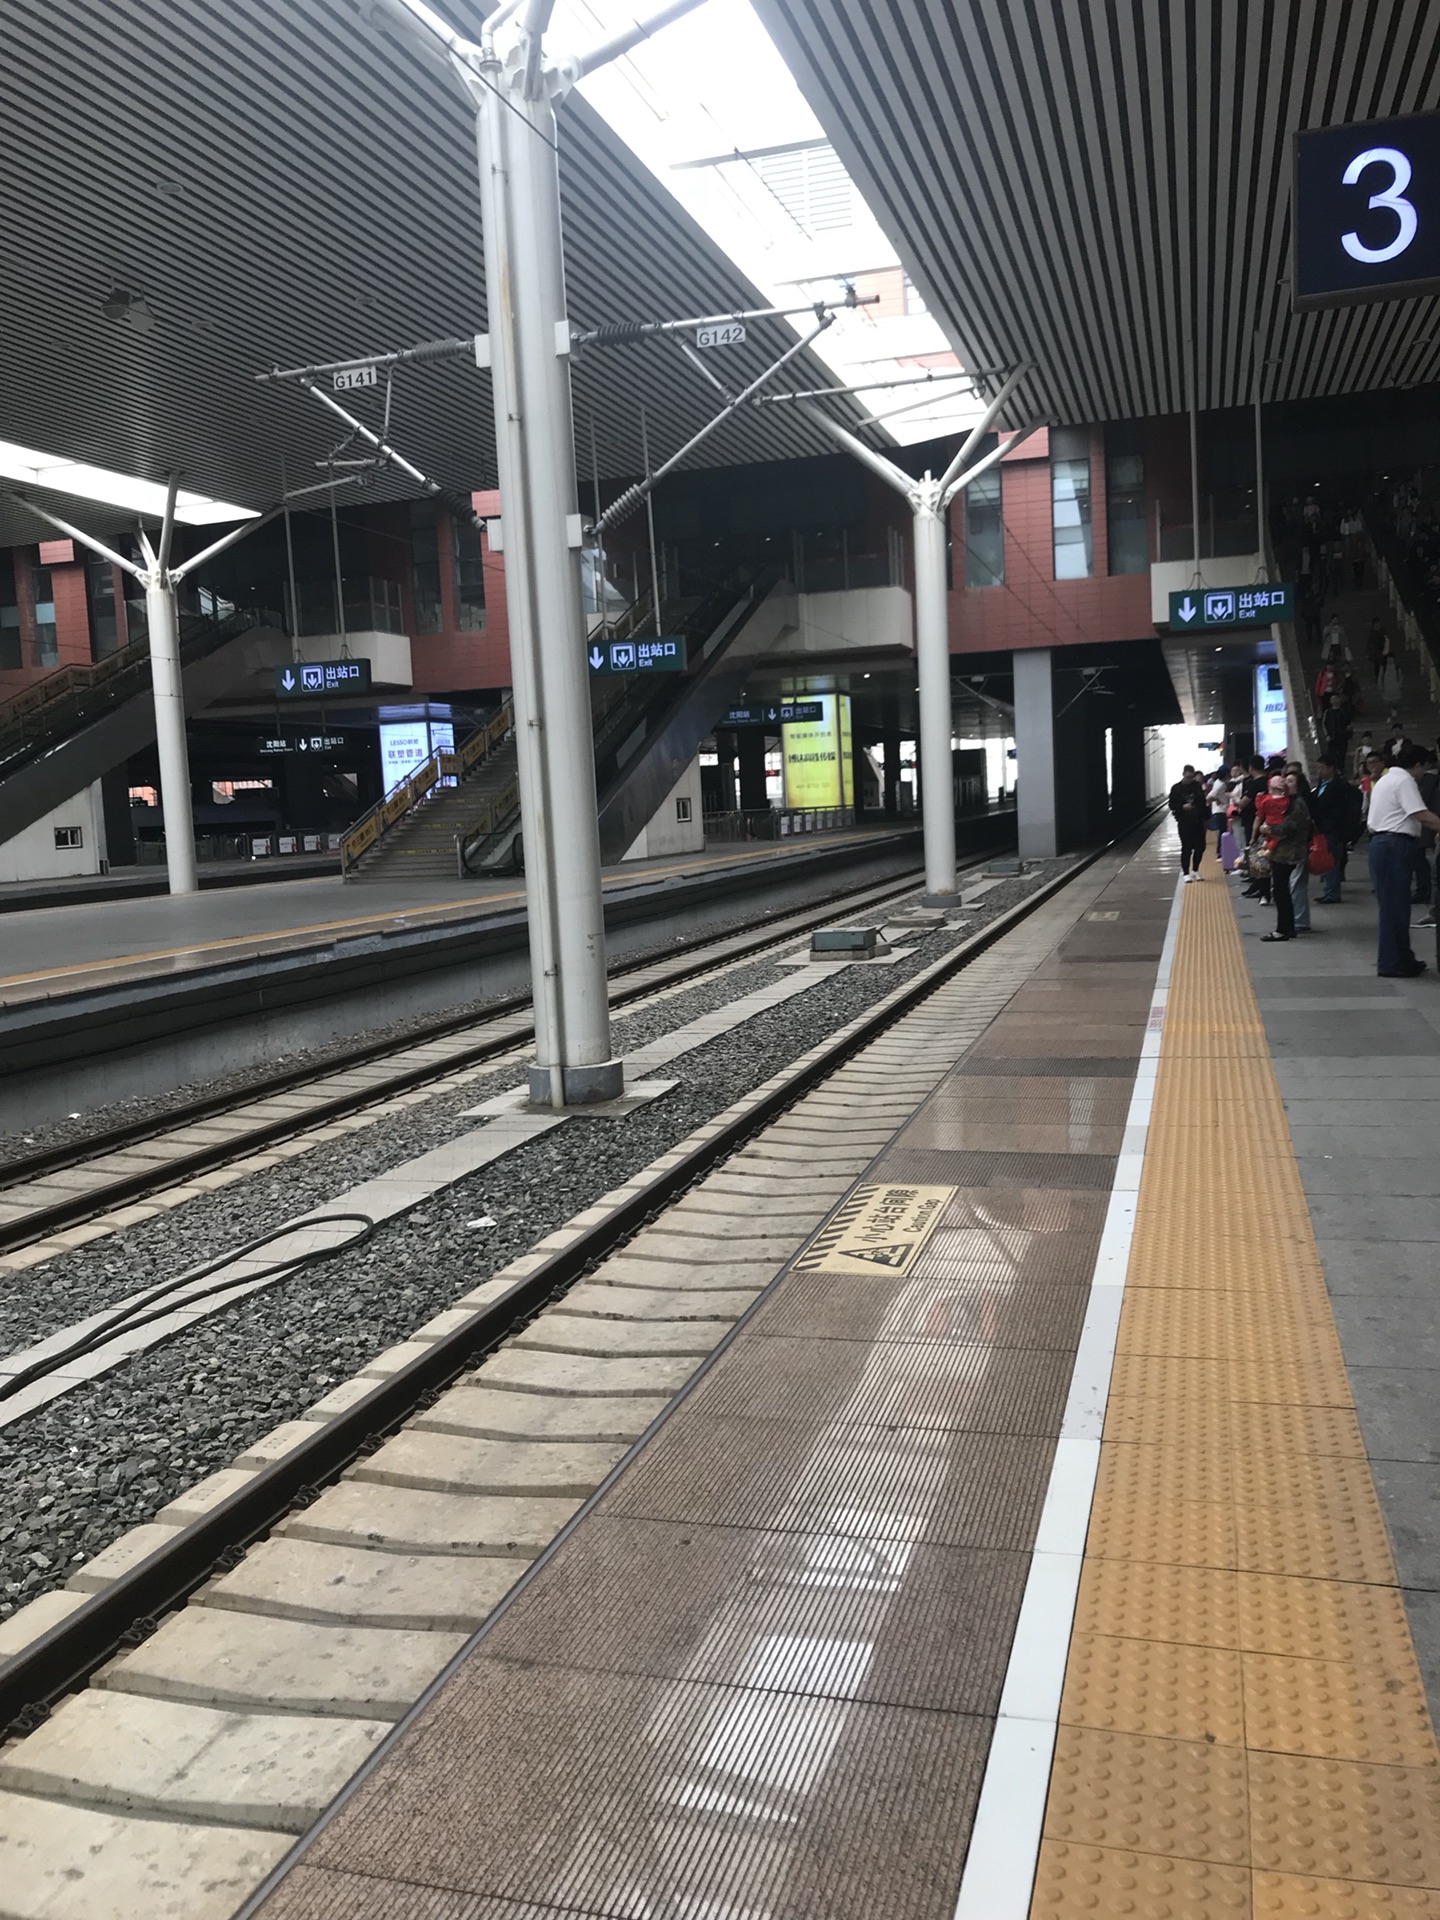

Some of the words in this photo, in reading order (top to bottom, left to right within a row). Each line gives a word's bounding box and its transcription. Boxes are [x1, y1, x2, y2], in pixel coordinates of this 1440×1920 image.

[1340, 147, 1418, 264] 3
[698, 327, 744, 346] G142
[335, 370, 372, 389] G141
[1238, 591, 1285, 609] 出站口
[1238, 609, 1256, 619] Exit
[637, 642, 676, 658] 出站口
[638, 658, 654, 667] Exit
[325, 665, 360, 680] 出站口
[326, 680, 339, 689] Exit
[265, 740, 287, 749] 沈阳站
[323, 736, 344, 745] 出站口
[387, 748, 423, 759] 联塑管道
[853, 1188, 919, 1243] 小心站台间隙
